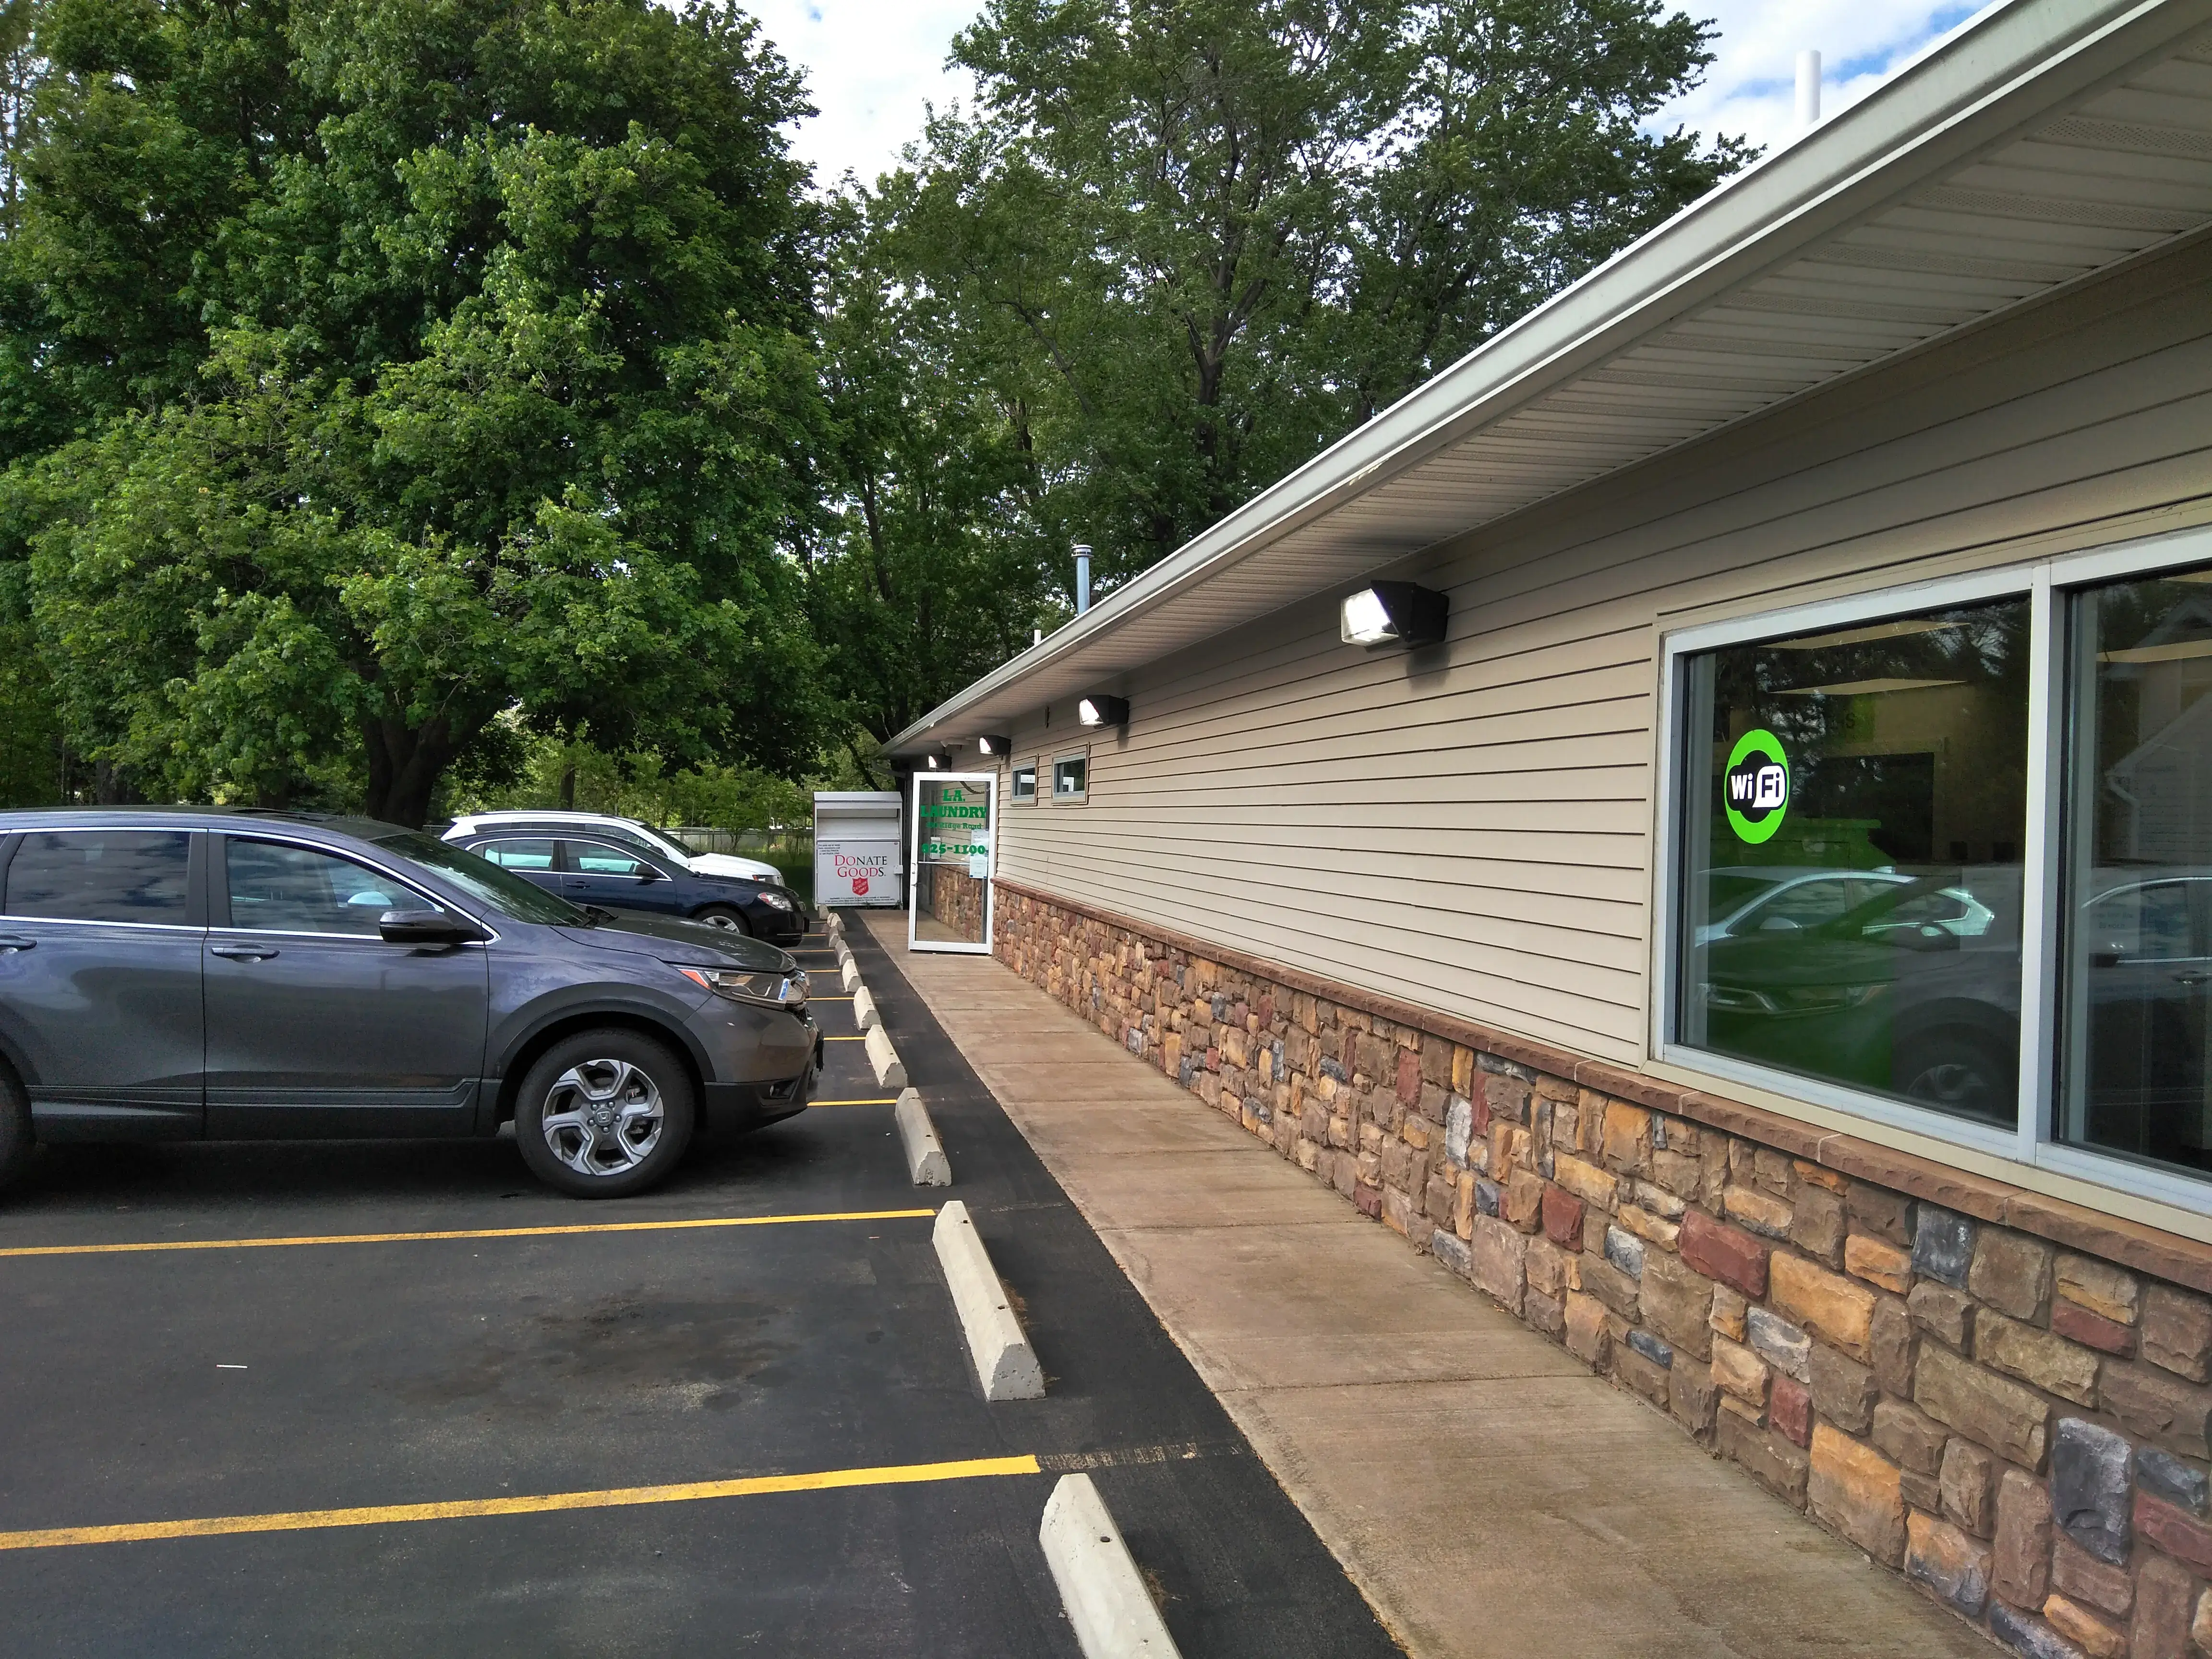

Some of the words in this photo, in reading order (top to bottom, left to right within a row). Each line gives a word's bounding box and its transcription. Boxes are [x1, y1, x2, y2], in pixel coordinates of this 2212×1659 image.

[920, 805, 988, 818] LAUNDRY
[939, 822, 961, 830] Ridge
[835, 855, 888, 866] DONATE
